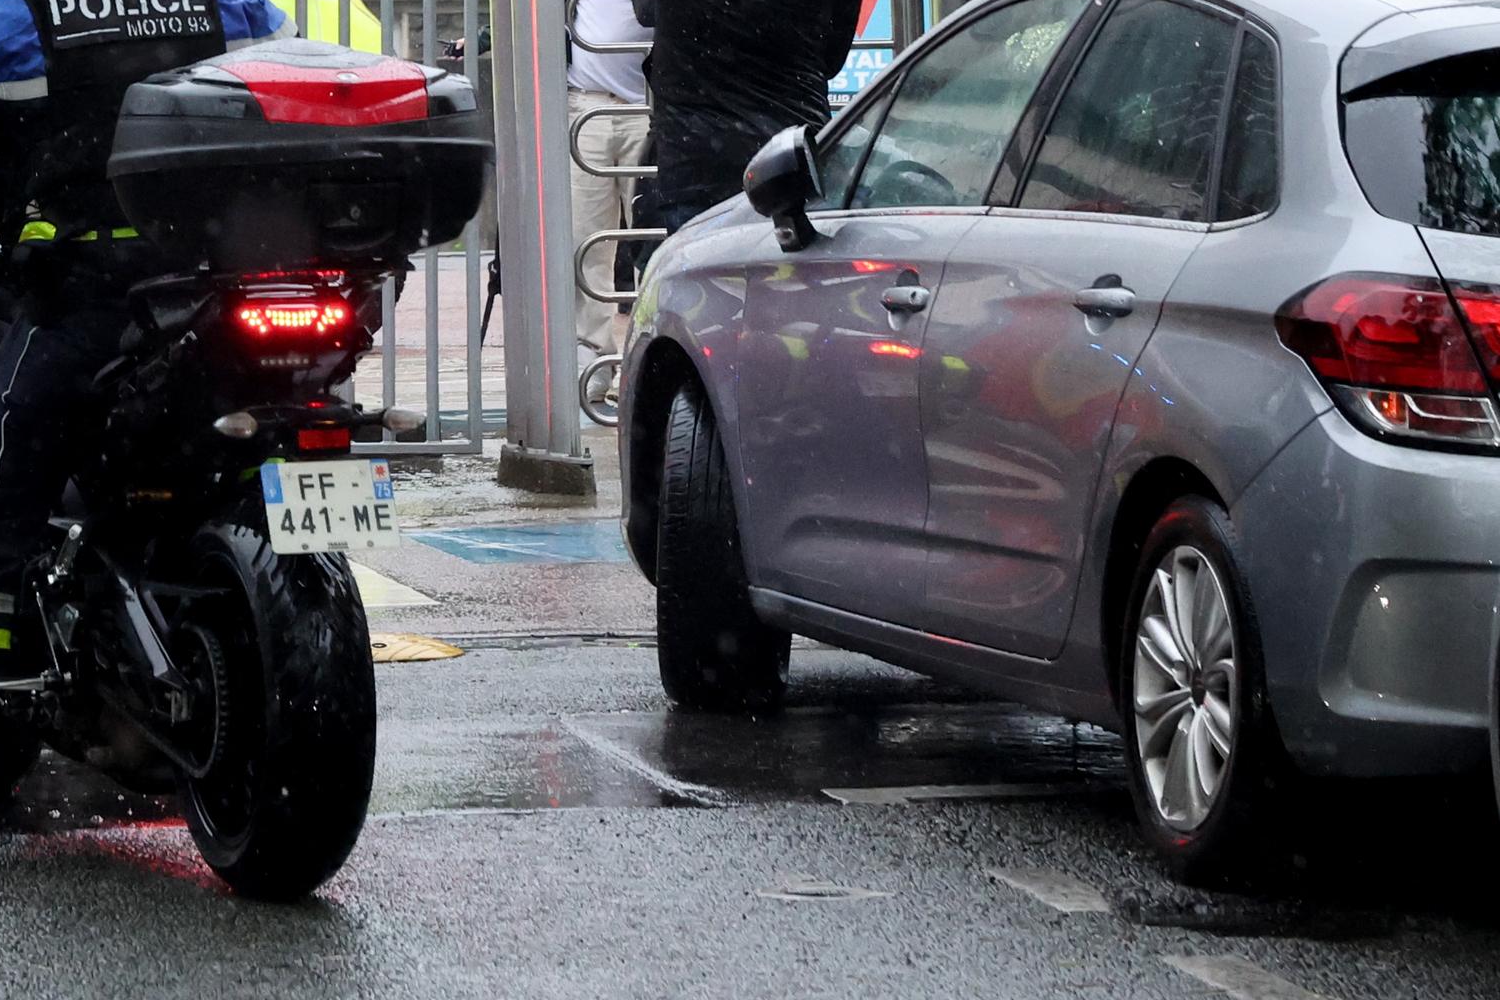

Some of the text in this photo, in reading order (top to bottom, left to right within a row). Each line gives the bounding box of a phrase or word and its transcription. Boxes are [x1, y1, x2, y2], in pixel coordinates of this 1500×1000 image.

[126, 16, 210, 37] MOTO 93
[375, 482, 391, 497] 75
